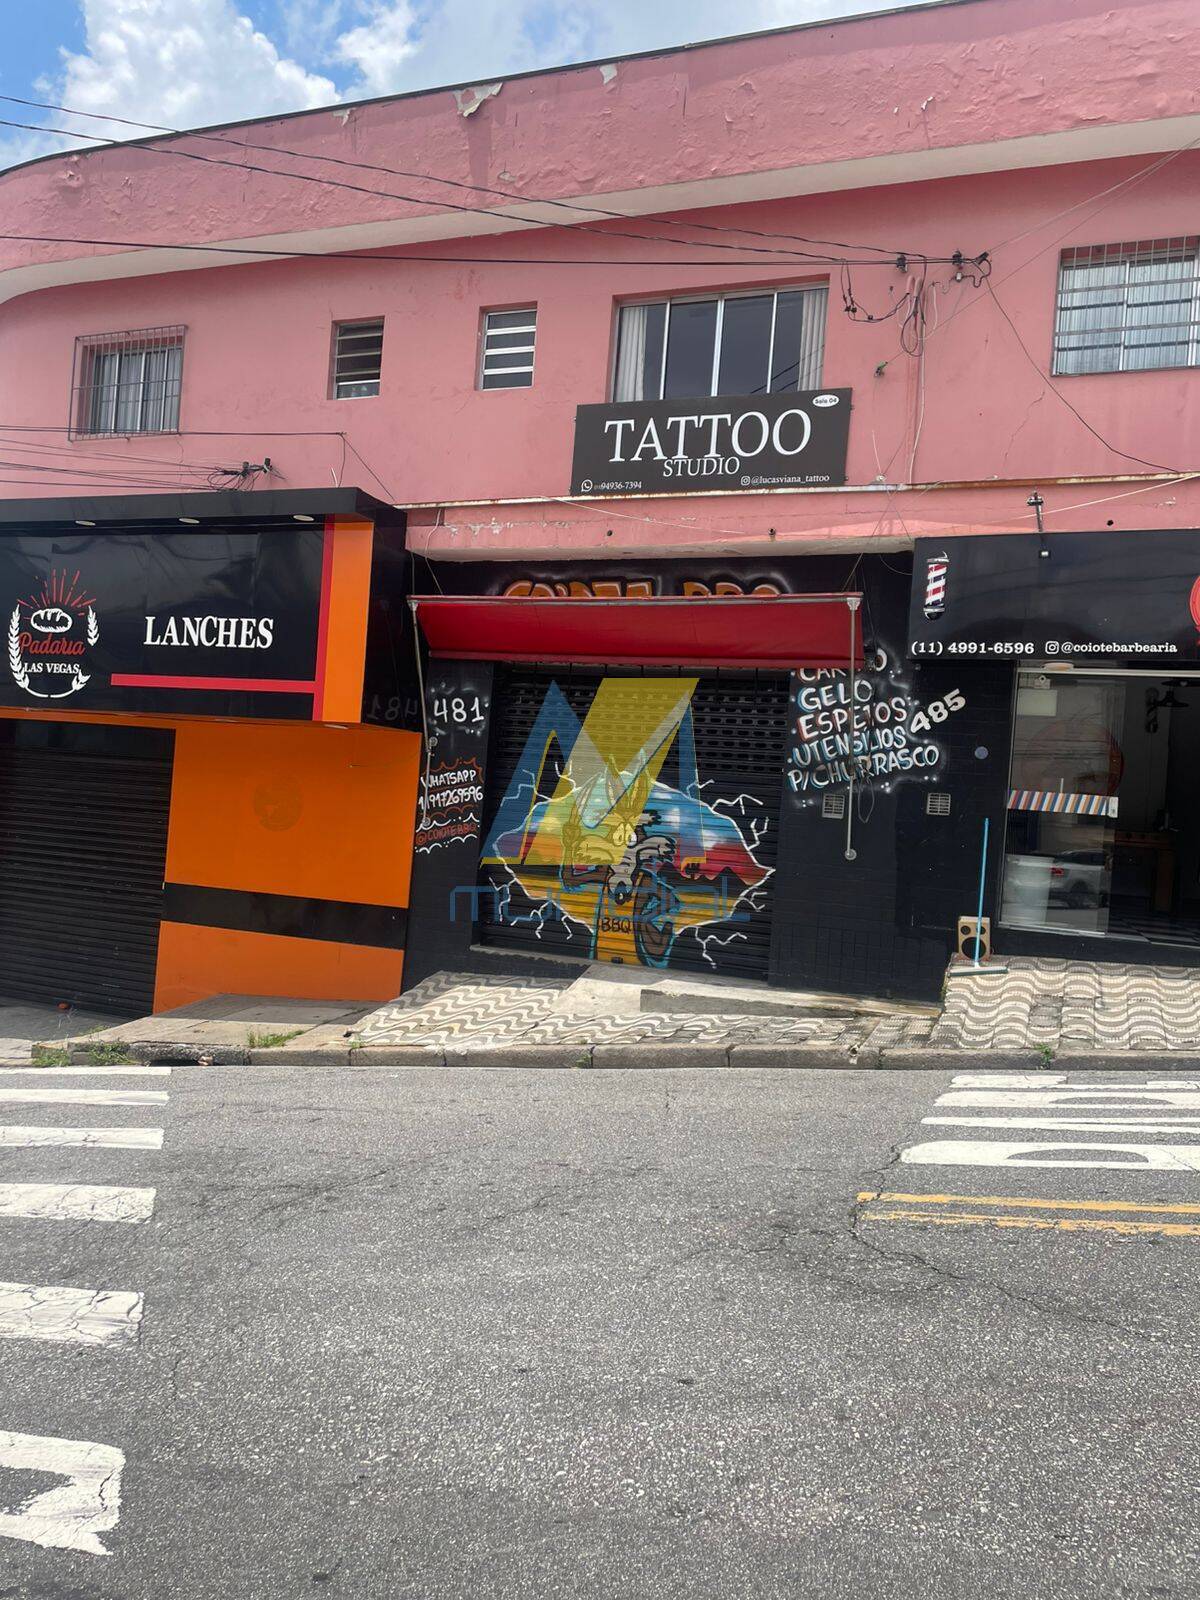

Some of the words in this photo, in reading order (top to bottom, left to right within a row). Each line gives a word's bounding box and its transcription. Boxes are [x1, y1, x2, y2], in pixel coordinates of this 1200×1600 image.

[604, 408, 812, 462] TATTOO
[663, 457, 740, 477] STUDIO
[751, 475, 830, 485] @lucasviana_tattoo
[143, 615, 274, 649] LANCHES
[18, 632, 86, 655] Padaria
[911, 641, 943, 656] (11)
[948, 641, 1035, 655] 4991-6596
[1061, 641, 1178, 655] @coiotebarbearia
[24, 662, 43, 673] LAS
[45, 662, 80, 674] VEGAS
[797, 679, 873, 712] GELO
[433, 696, 485, 723] 481
[910, 688, 967, 734] 485
[420, 769, 477, 788] WHATSAPP
[600, 916, 632, 934] BBQ
